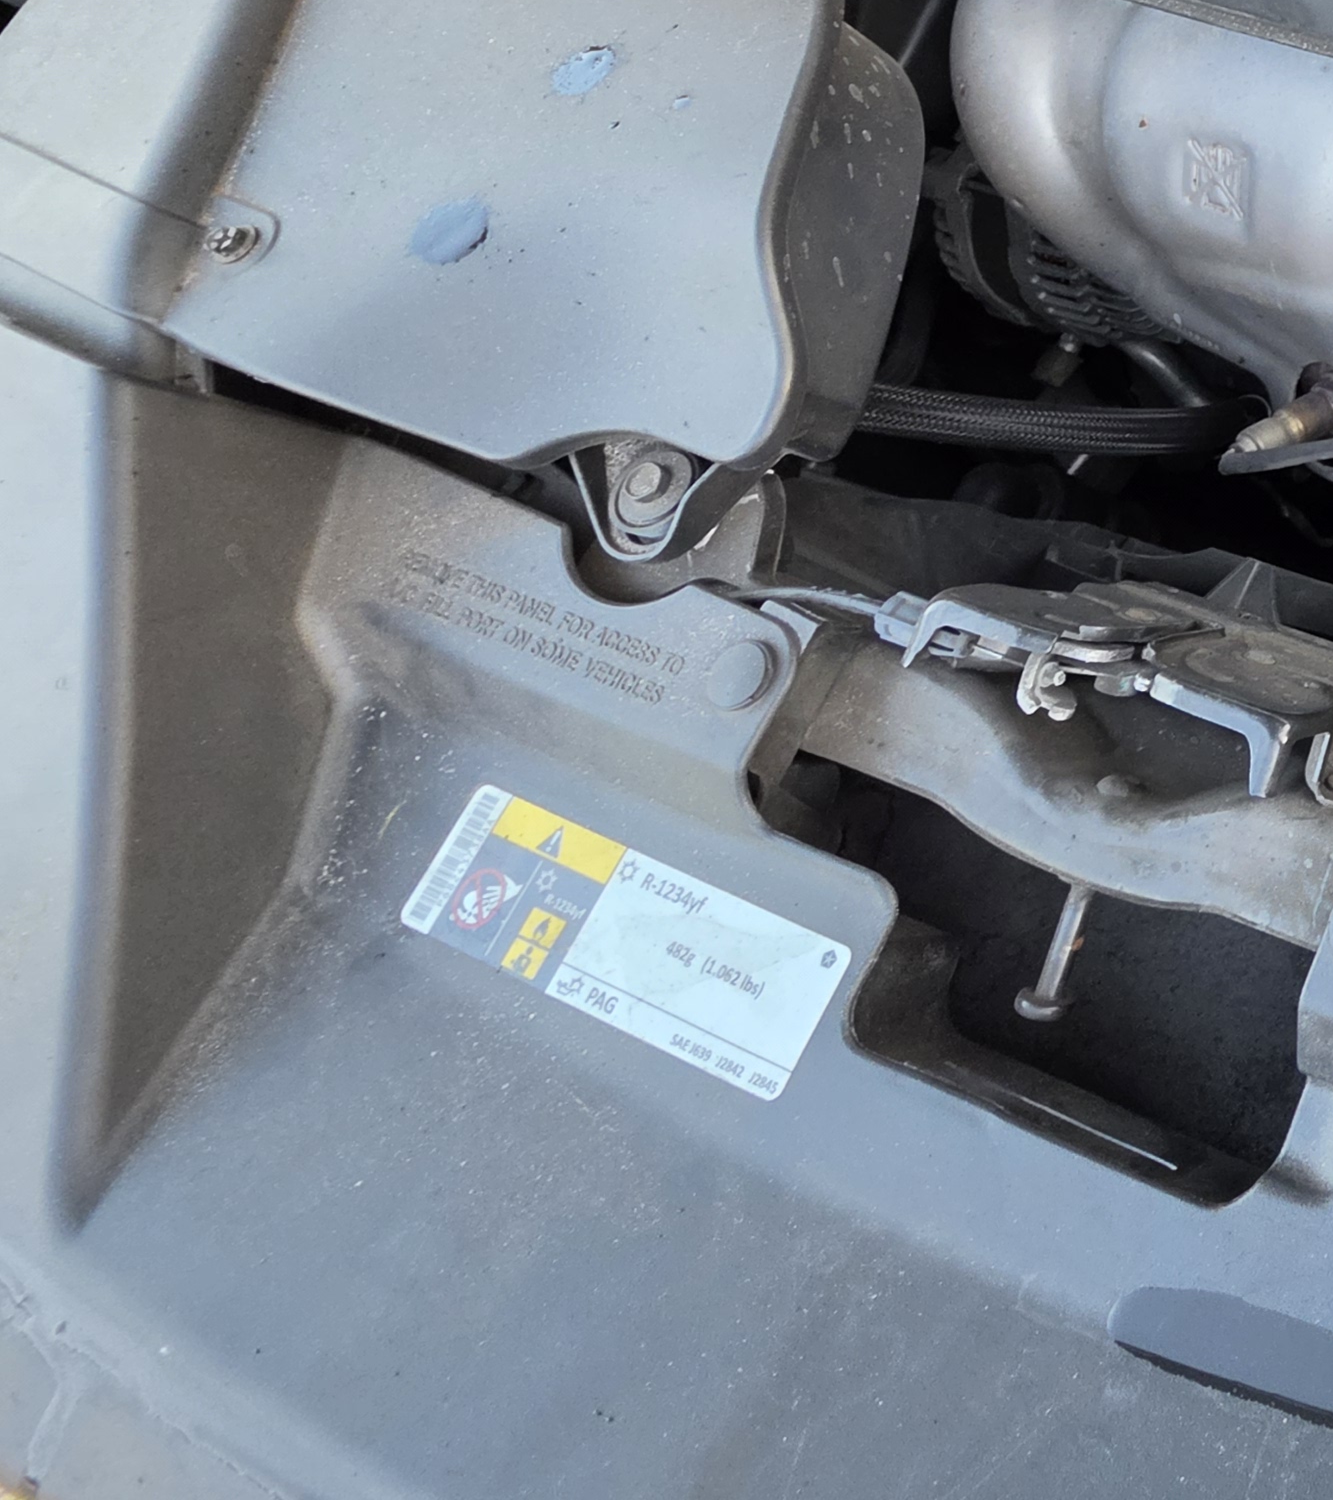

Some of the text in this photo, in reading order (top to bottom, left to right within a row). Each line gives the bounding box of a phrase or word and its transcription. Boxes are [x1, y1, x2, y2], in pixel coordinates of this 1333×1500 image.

[456, 605, 505, 638] PORT
[503, 624, 534, 652] ON
[531, 637, 583, 672] SOME
[583, 655, 666, 706] VEHICLES
[469, 574, 686, 677] THIS PANEL FOR ACCESS TO
[639, 872, 710, 915] R-1234yf
[665, 940, 766, 1000] 482g (1.062 lbs)
[584, 987, 619, 1015] PAG
[669, 1033, 779, 1095] SAE J639 J2842 J2845
